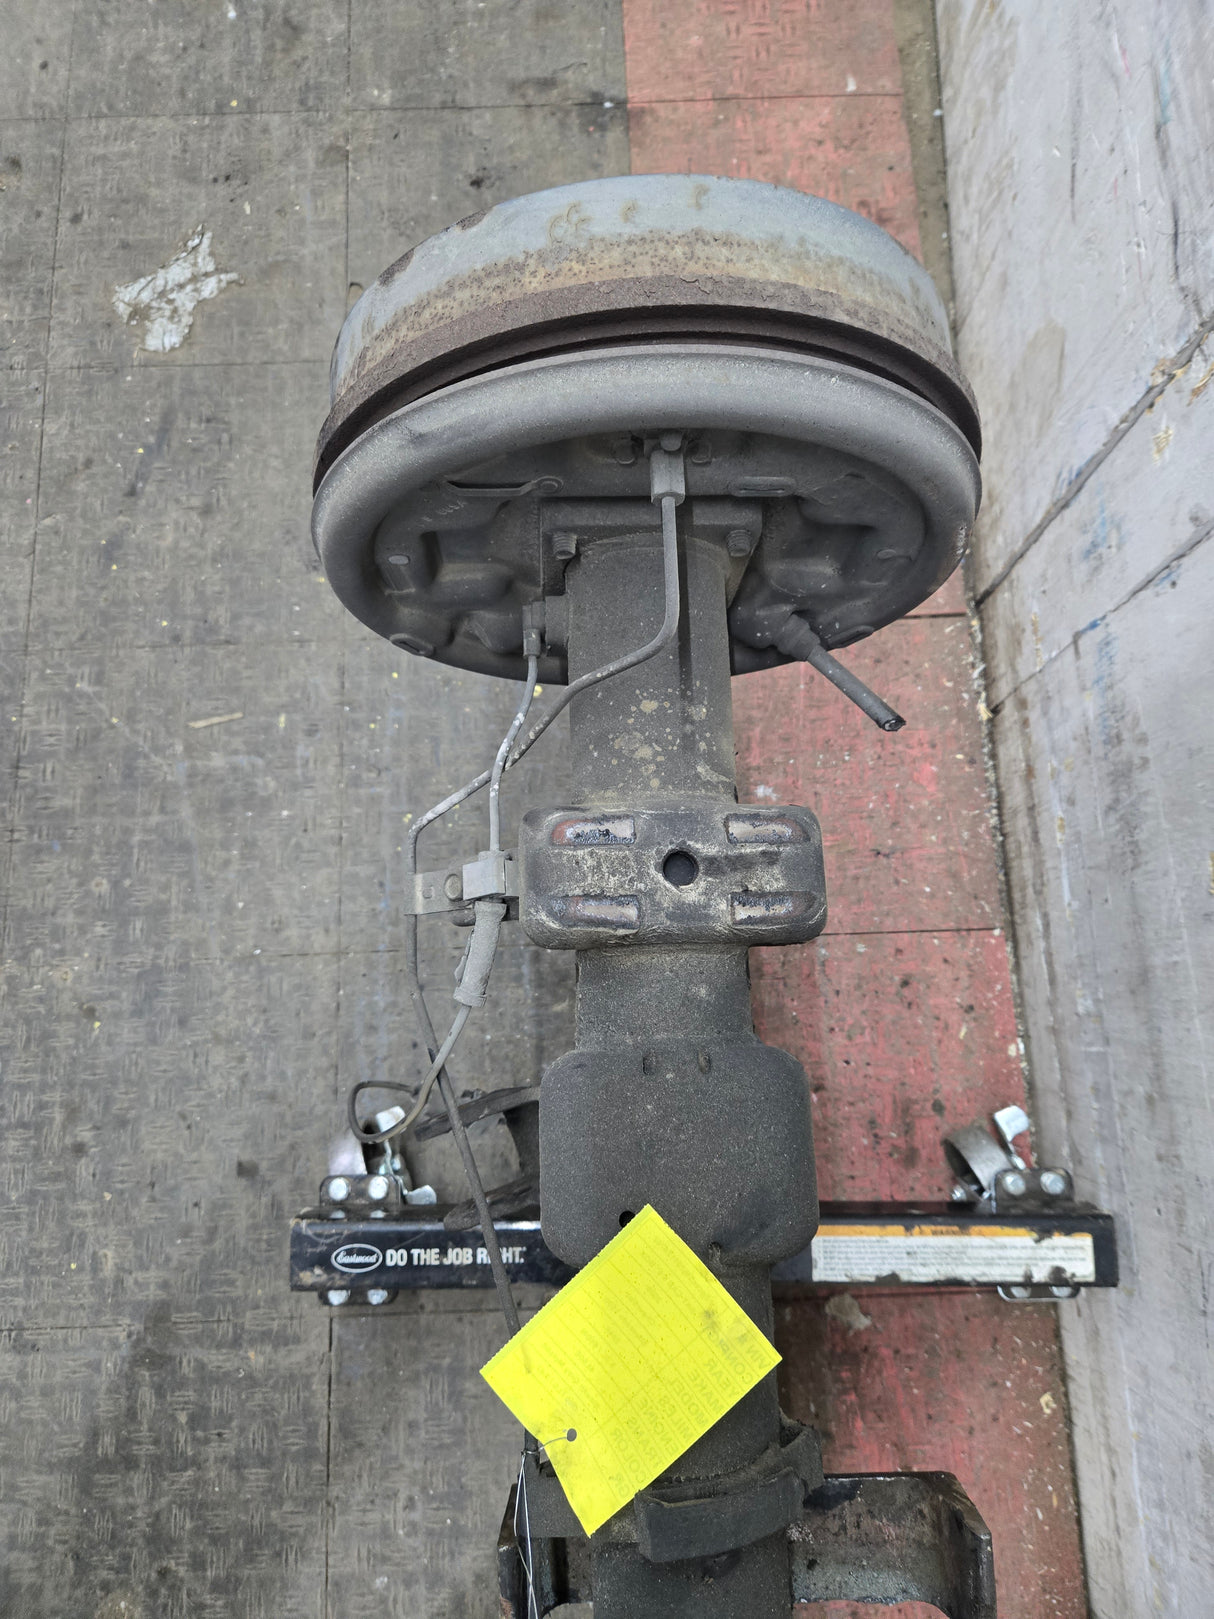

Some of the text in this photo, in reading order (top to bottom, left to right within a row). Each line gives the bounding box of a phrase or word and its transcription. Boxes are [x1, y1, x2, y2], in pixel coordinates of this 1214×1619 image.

[386, 1246, 526, 1267] DO THE JOB RHT.
